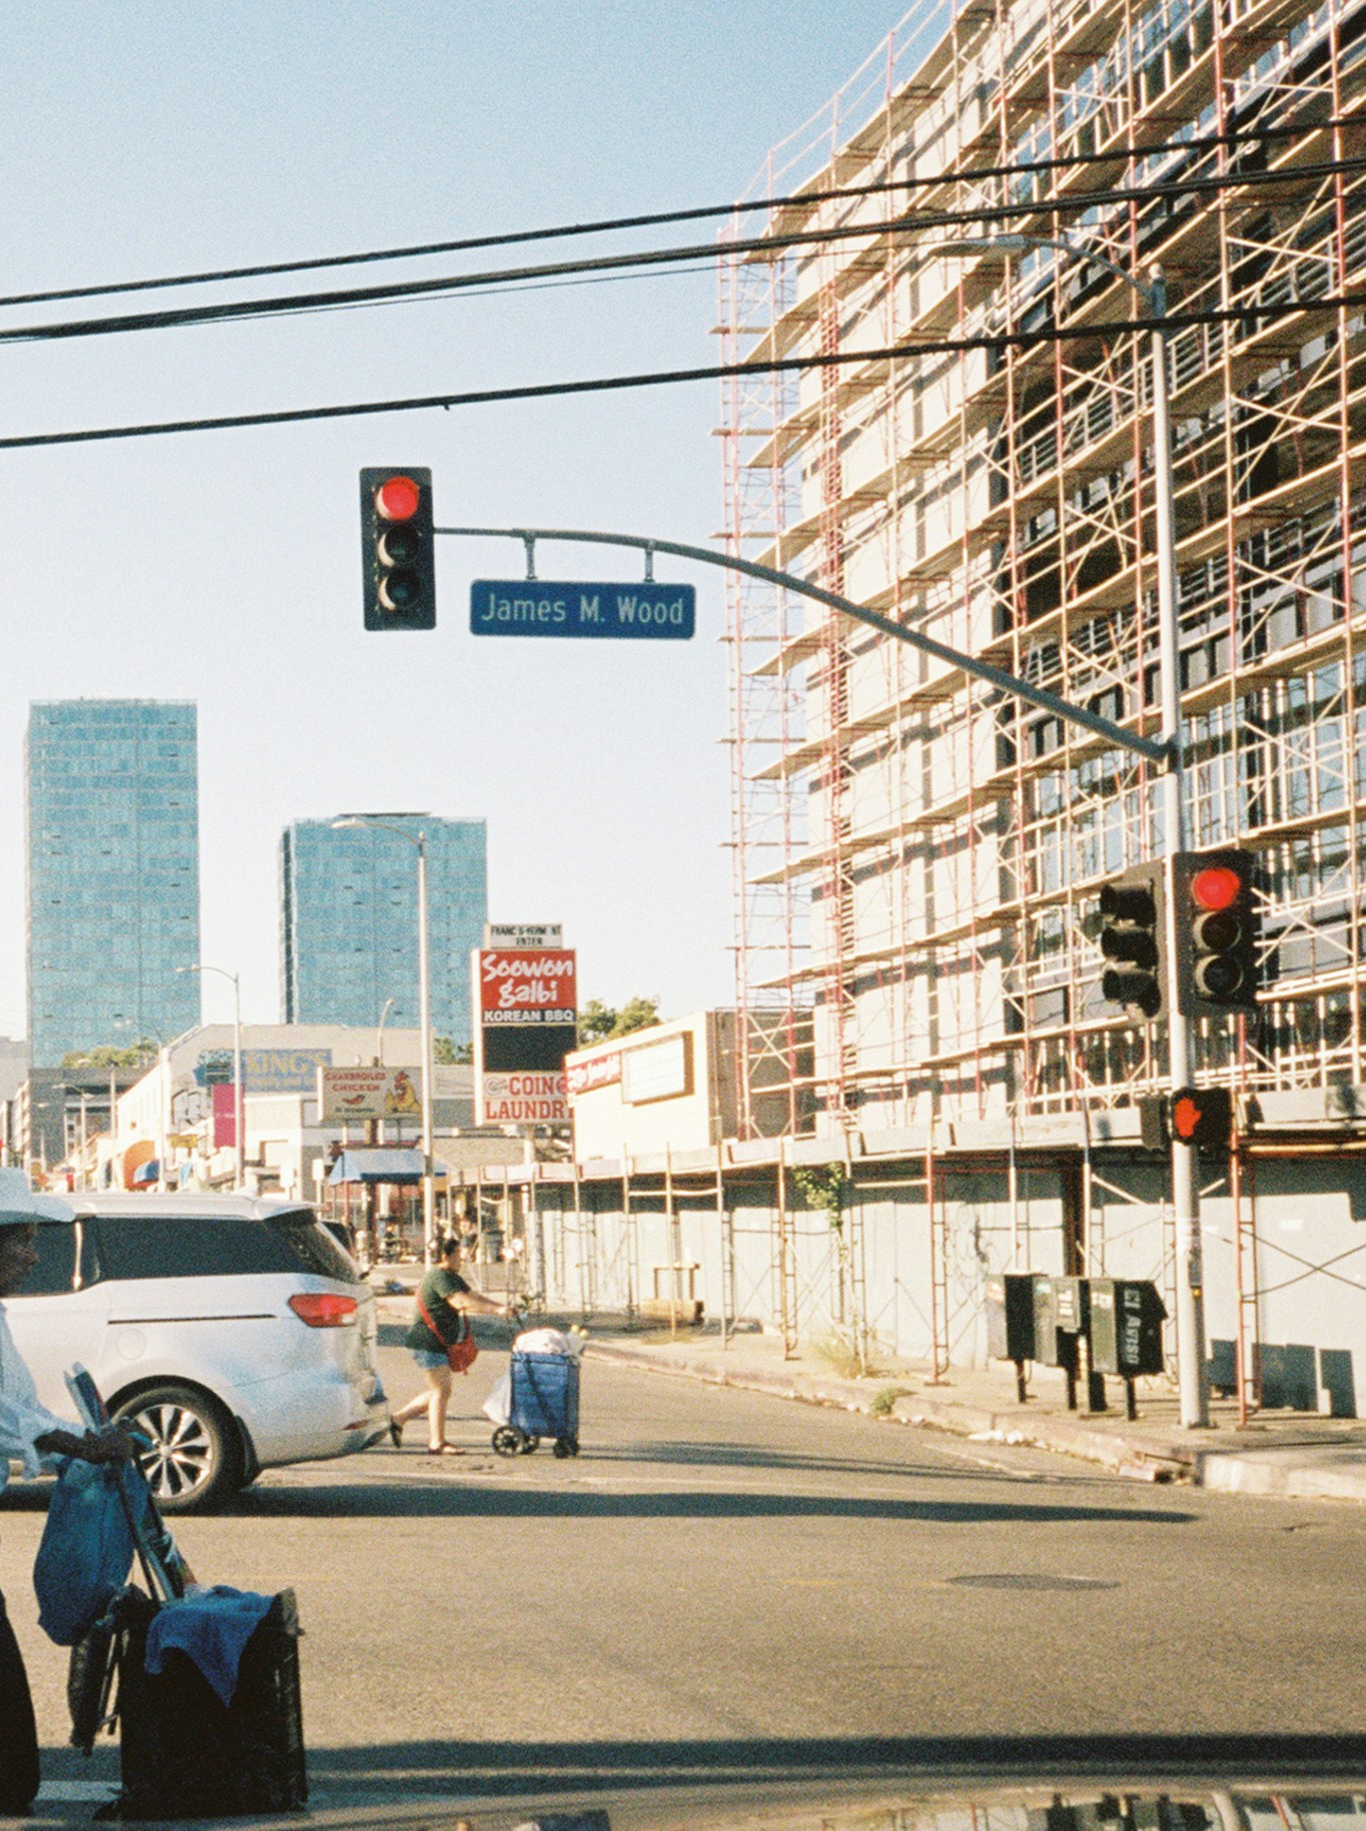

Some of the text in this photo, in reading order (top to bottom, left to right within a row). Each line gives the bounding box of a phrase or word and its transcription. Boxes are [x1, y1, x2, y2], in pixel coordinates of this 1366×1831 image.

[481, 593, 684, 623] James M. Wood
[482, 953, 574, 983] Soowon
[498, 978, 558, 1009] galbi
[484, 1010, 575, 1023] KOREAN BBQ
[332, 1083, 381, 1092] CHICKEN
[509, 1076, 555, 1096] COIN
